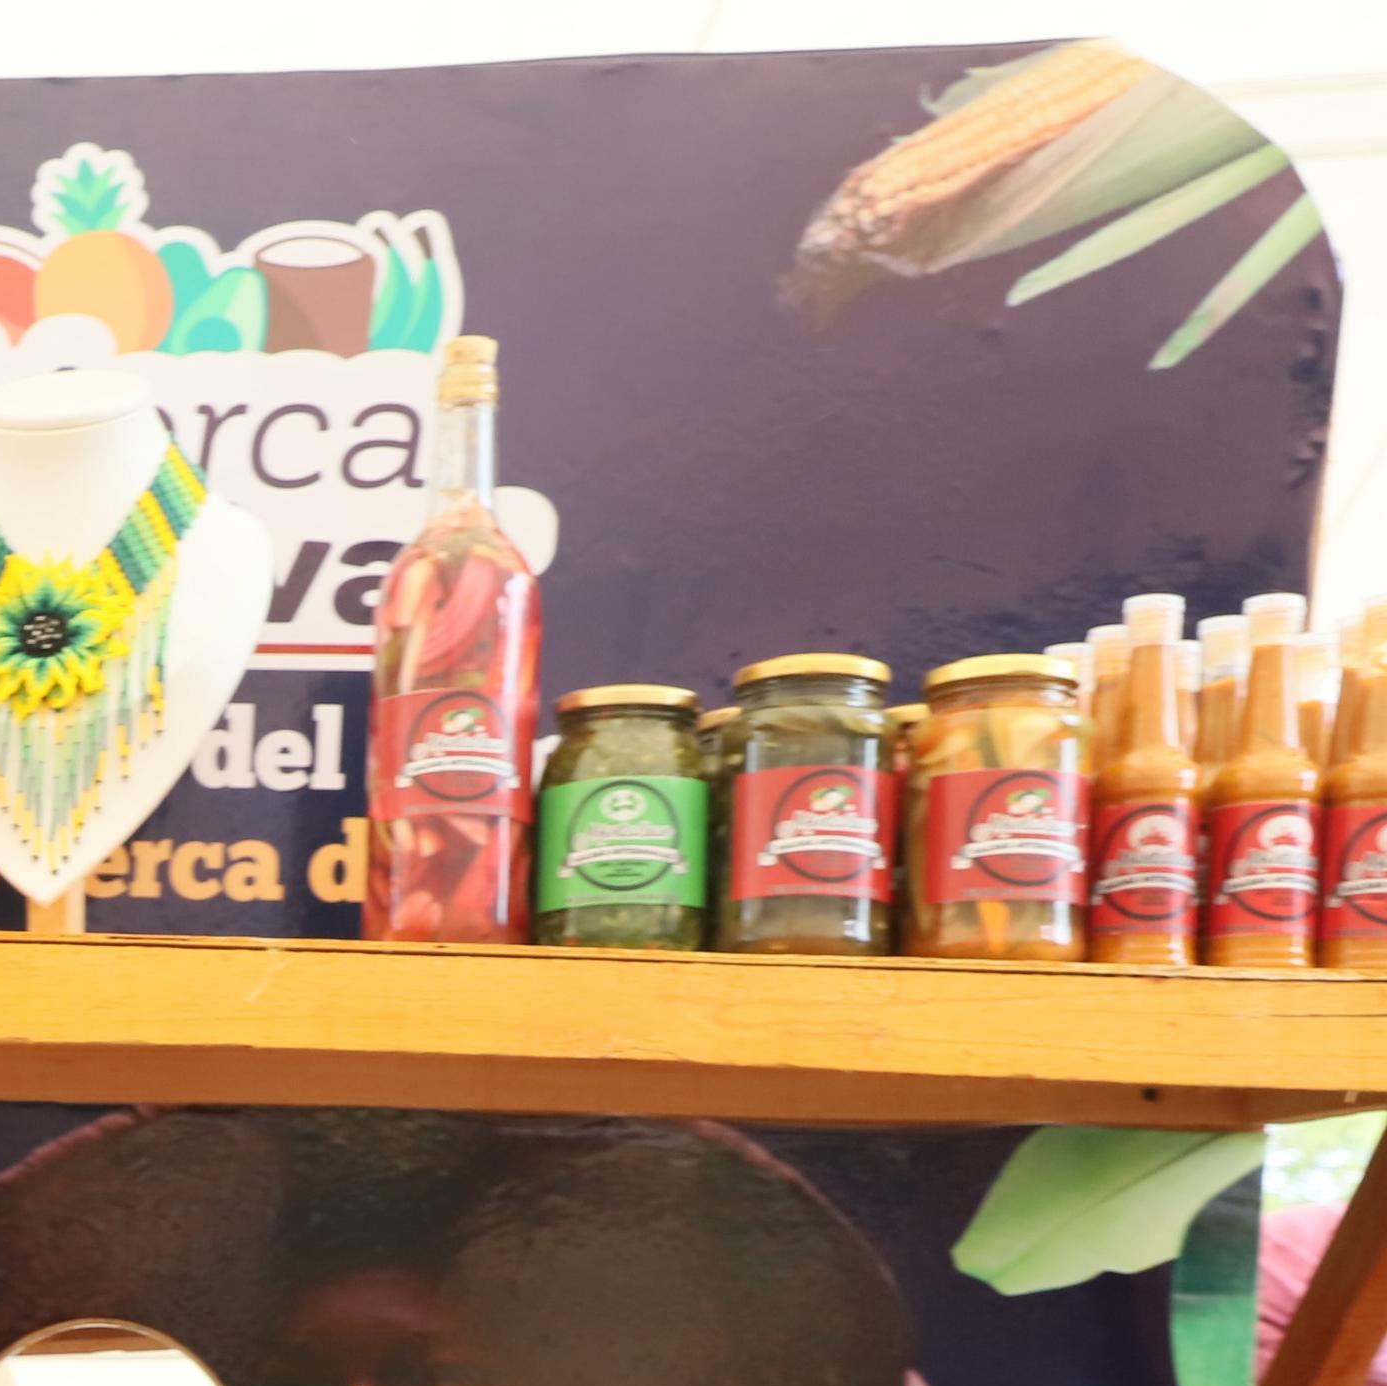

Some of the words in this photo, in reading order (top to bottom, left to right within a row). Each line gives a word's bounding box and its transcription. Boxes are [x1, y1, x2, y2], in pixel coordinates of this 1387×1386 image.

[190, 702, 347, 792] del
[84, 837, 286, 903] erca
[307, 816, 369, 904] d
